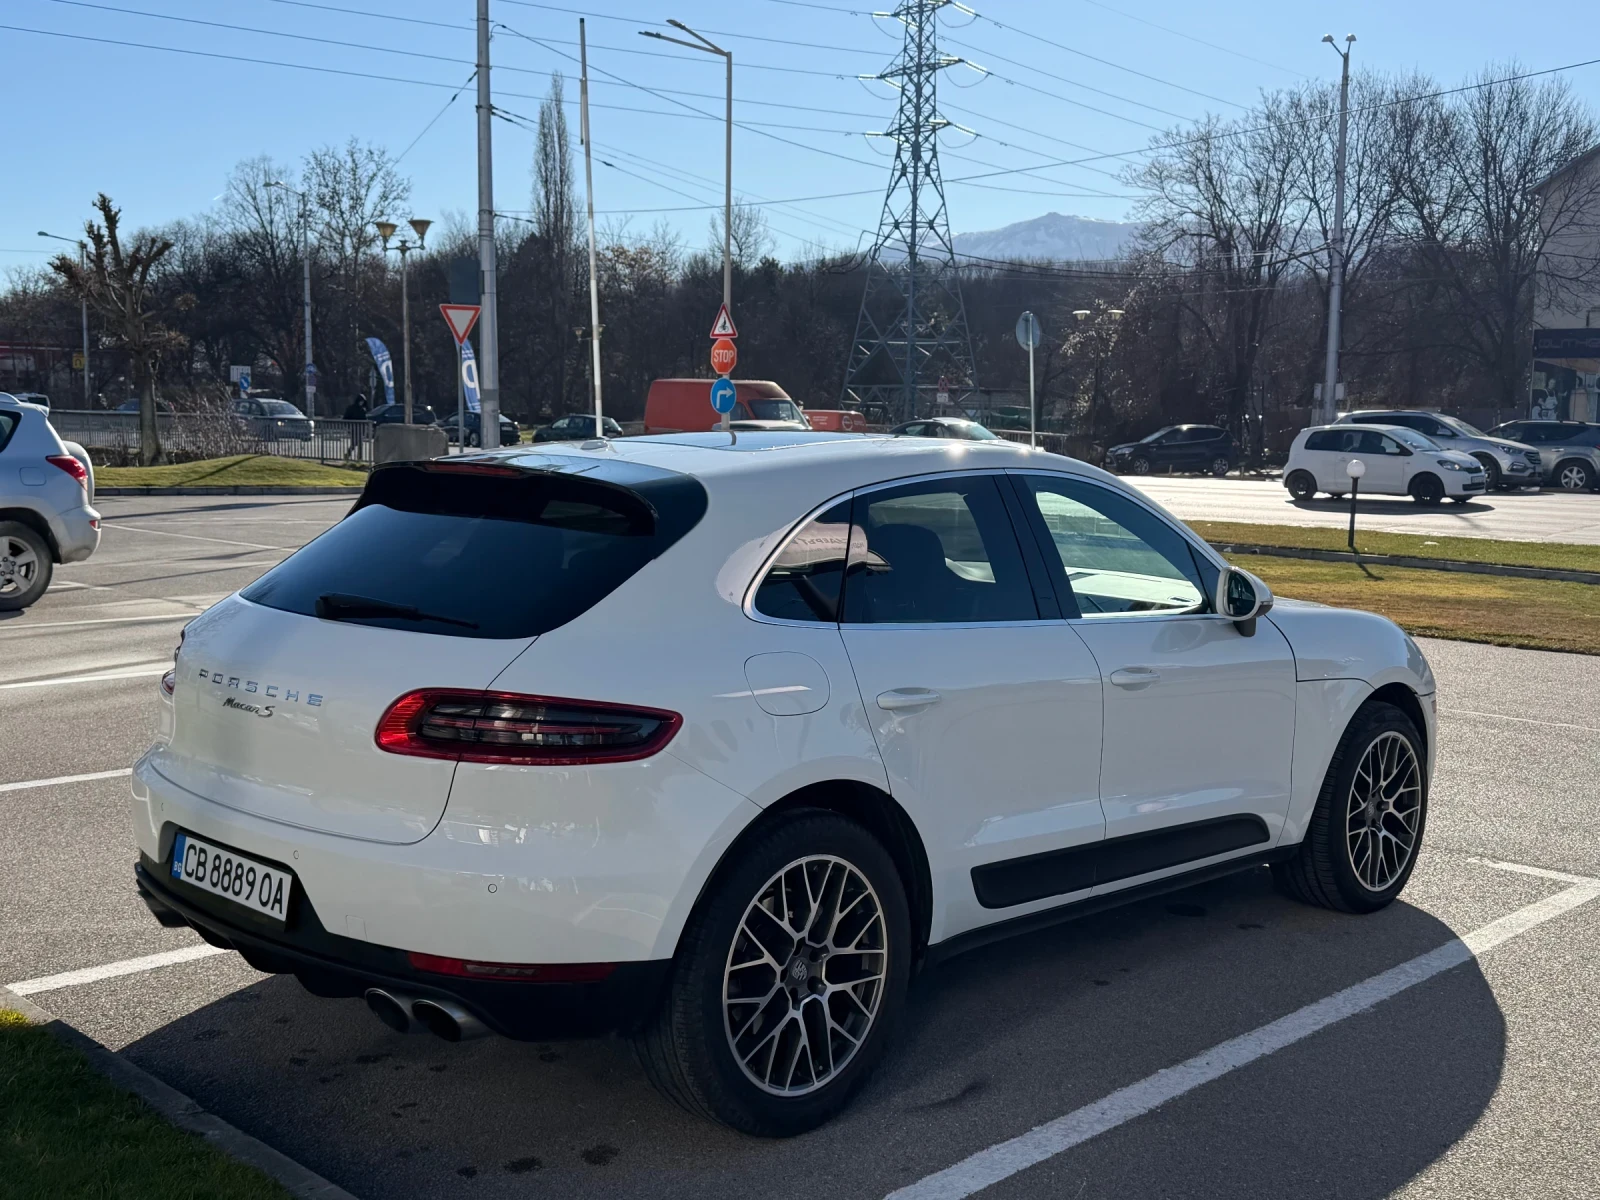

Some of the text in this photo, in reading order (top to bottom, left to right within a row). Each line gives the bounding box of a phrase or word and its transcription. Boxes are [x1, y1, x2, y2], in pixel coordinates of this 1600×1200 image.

[714, 350, 735, 363] STOP
[199, 668, 324, 707] PORSCHE
[223, 697, 276, 718] Macan S
